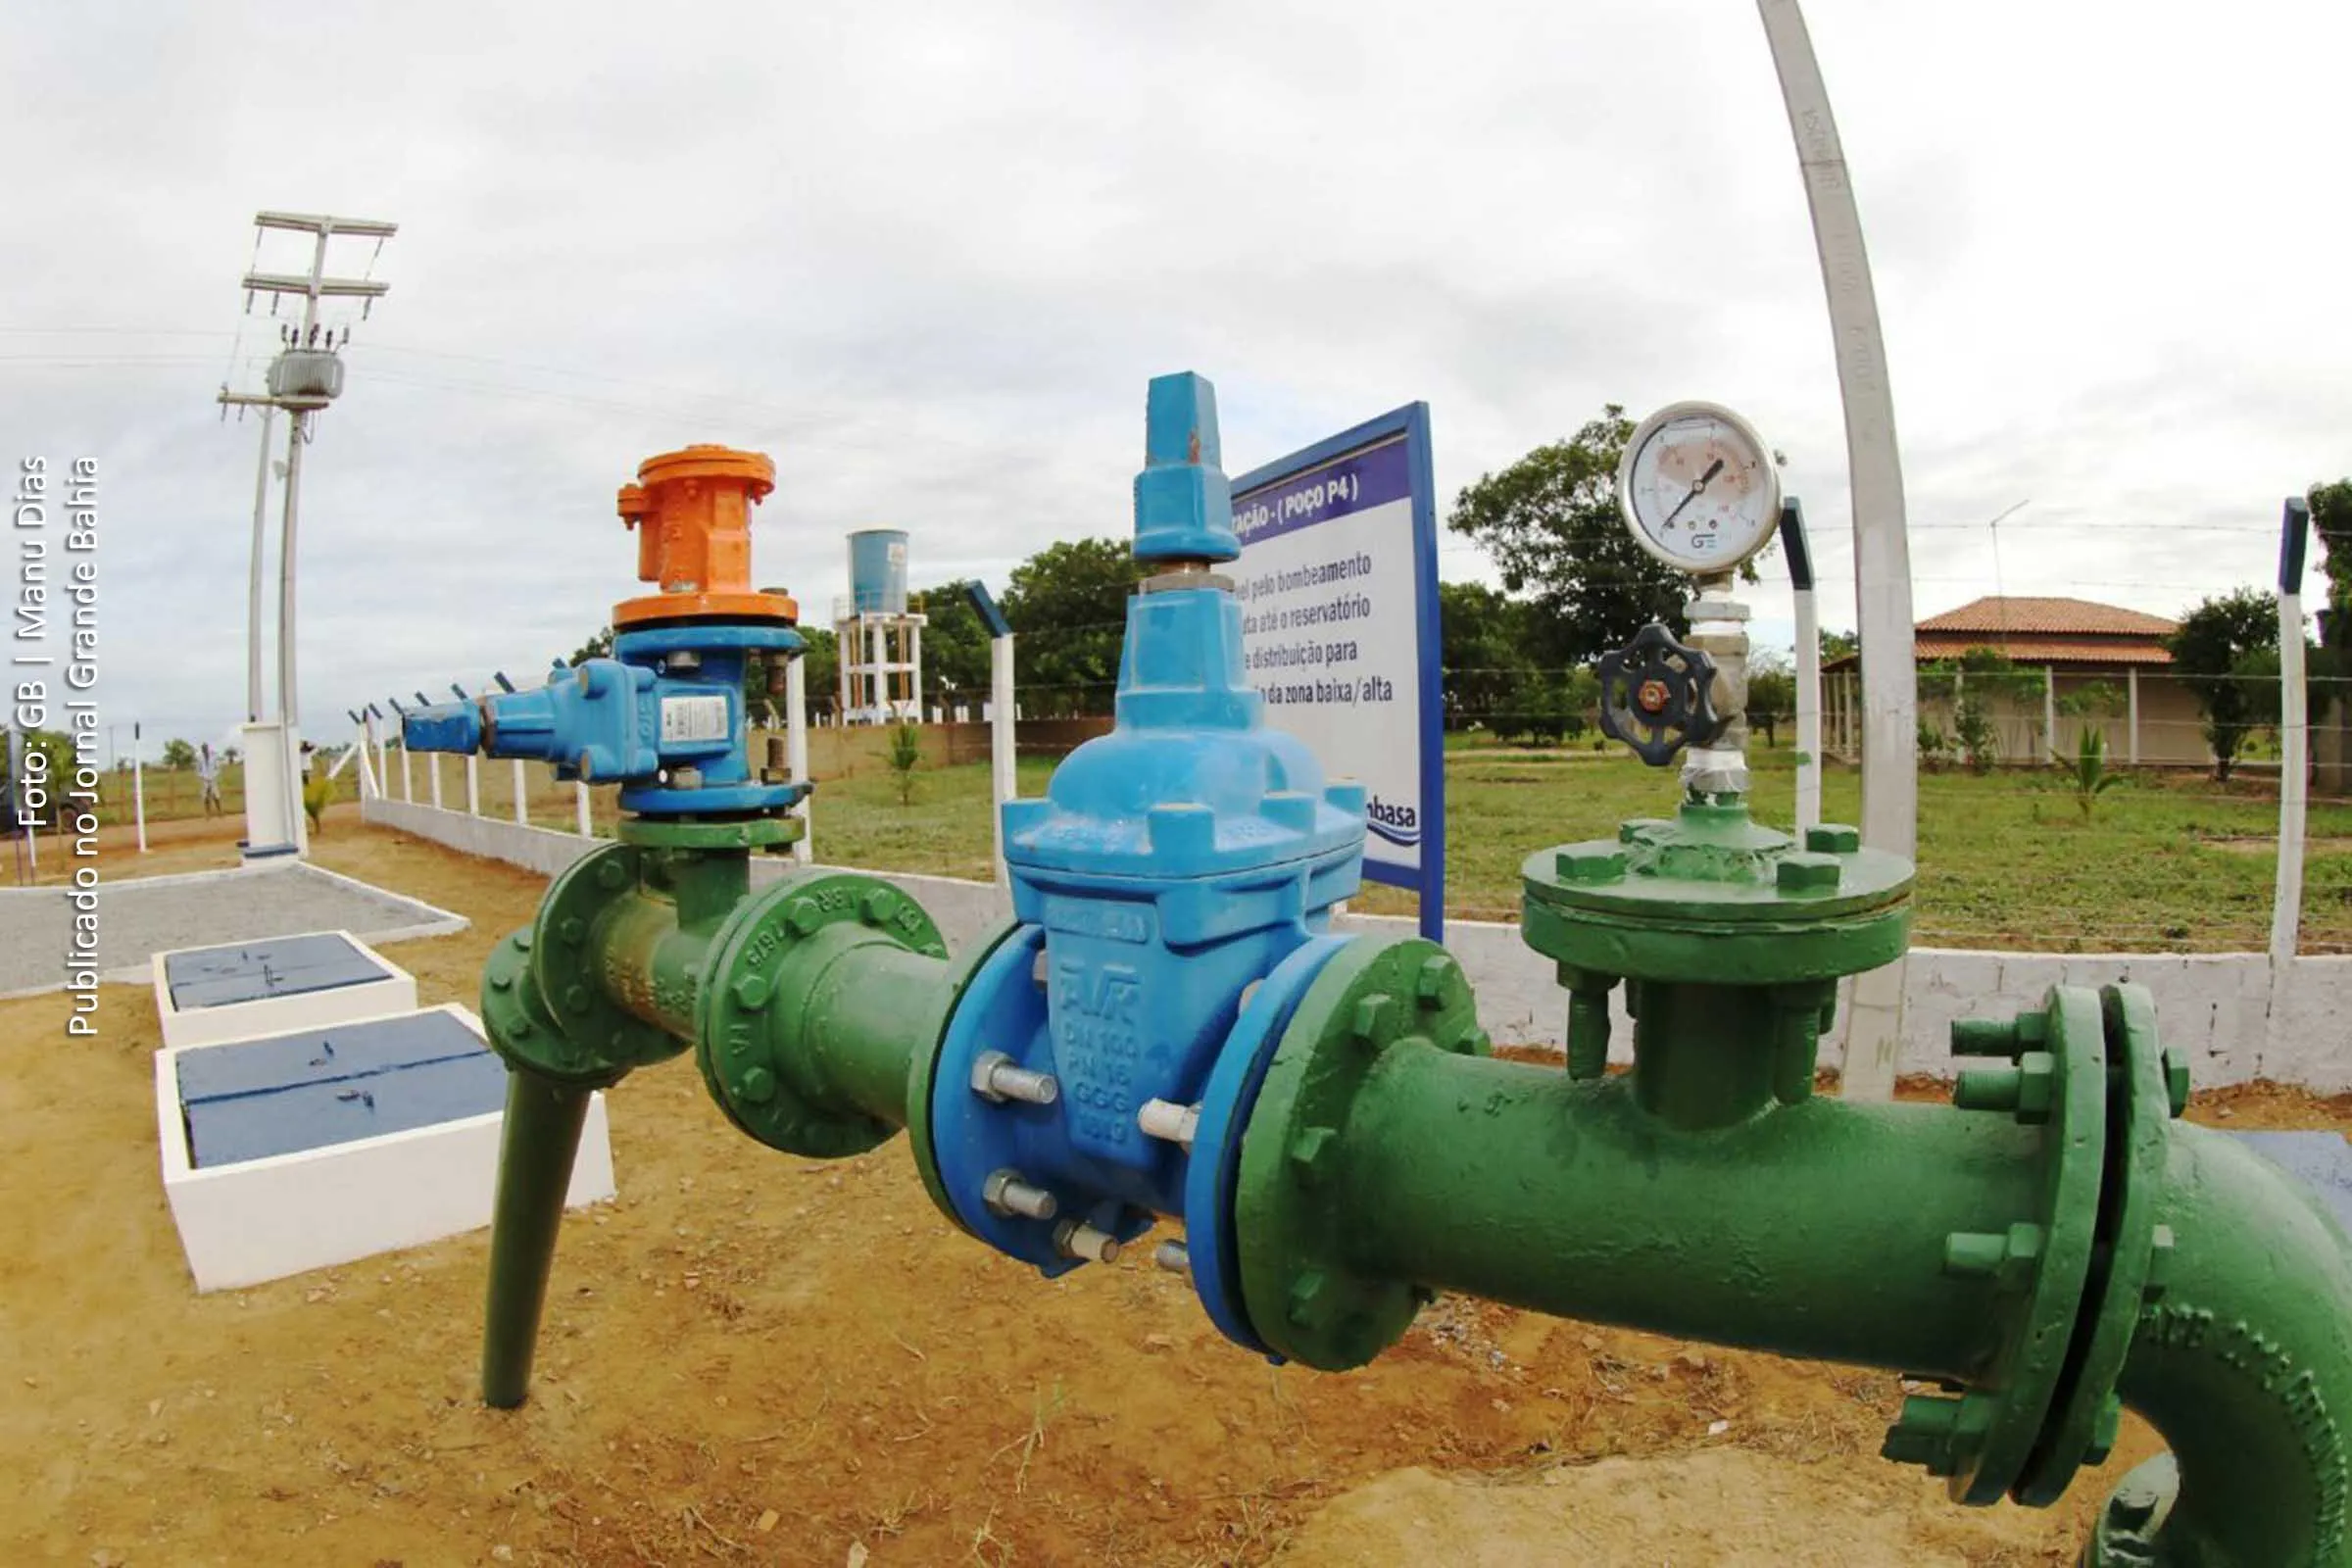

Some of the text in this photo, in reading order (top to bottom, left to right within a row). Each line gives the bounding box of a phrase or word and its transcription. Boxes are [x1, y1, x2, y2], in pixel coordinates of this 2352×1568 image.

[1252, 572, 1275, 605] pelo
[1277, 550, 1371, 593] bombeamento
[1280, 611, 1287, 630] o
[1290, 590, 1370, 628] reservatório
[1252, 639, 1322, 672] distribuição
[1325, 640, 1357, 668] para
[1268, 682, 1282, 705] da
[1286, 683, 1313, 705] zona
